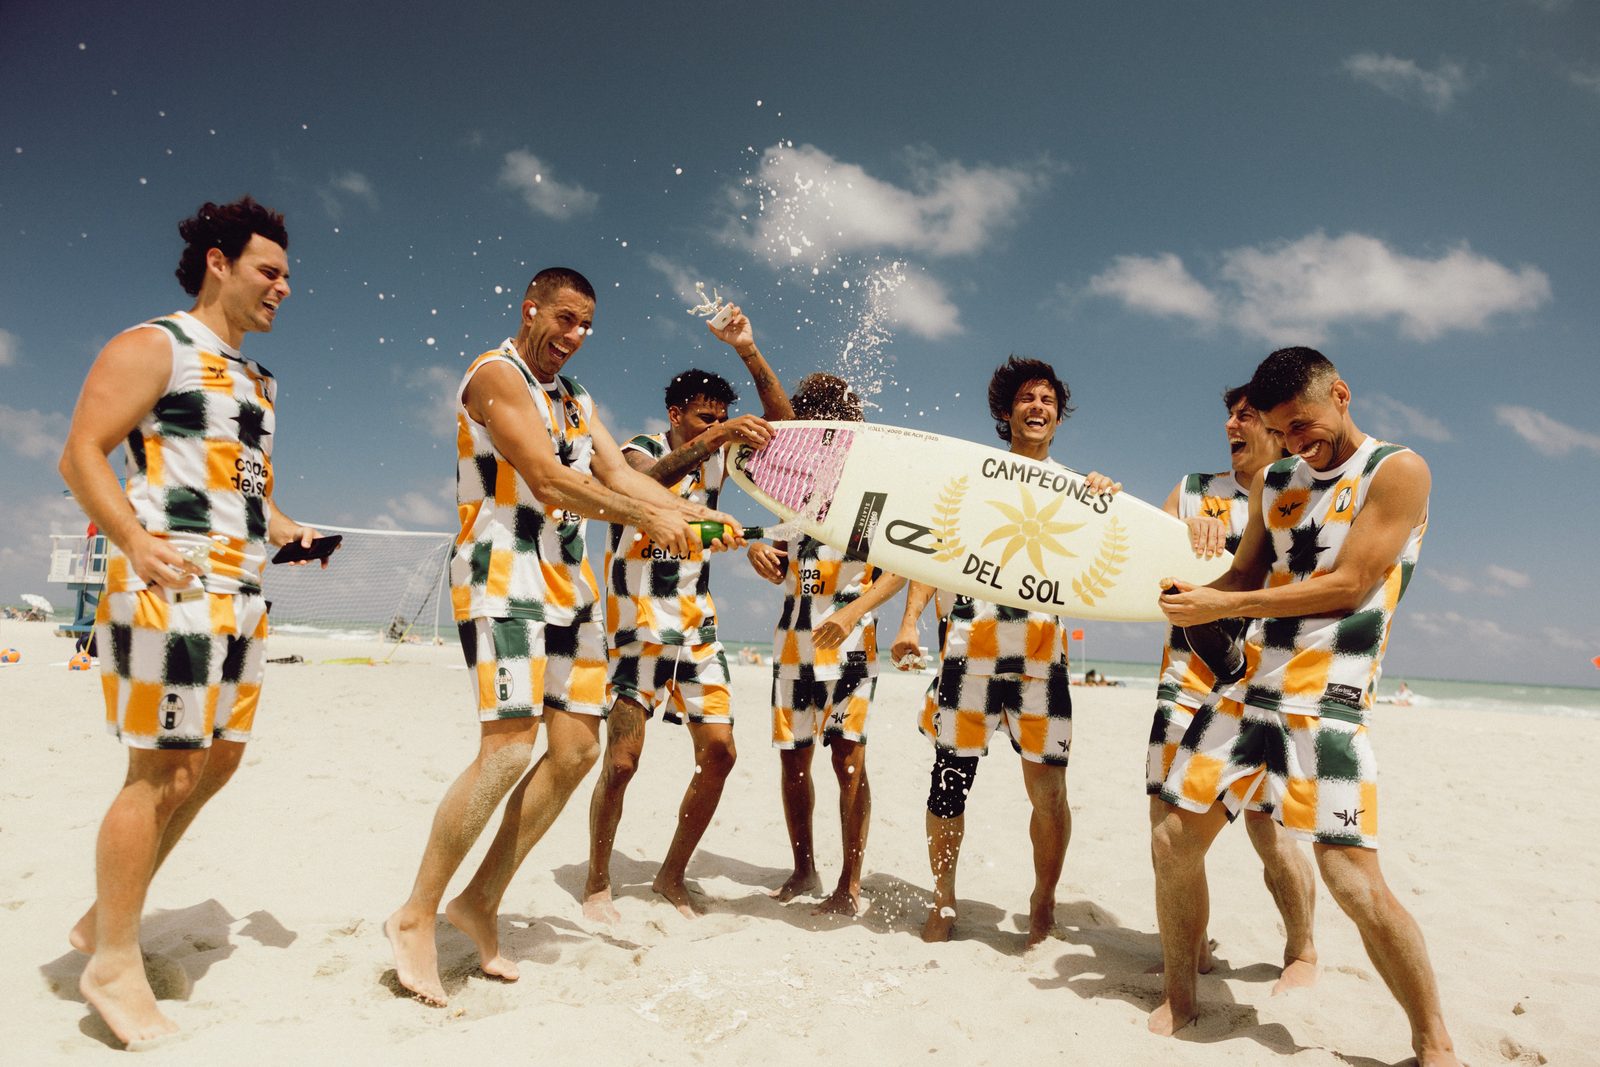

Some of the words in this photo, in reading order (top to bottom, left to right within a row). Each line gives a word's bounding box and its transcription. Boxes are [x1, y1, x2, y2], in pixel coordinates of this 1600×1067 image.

[982, 458, 1113, 514] CAMPEONES
[803, 580, 826, 595] sol
[962, 553, 1003, 590] DEL
[1018, 574, 1065, 606] SOL
